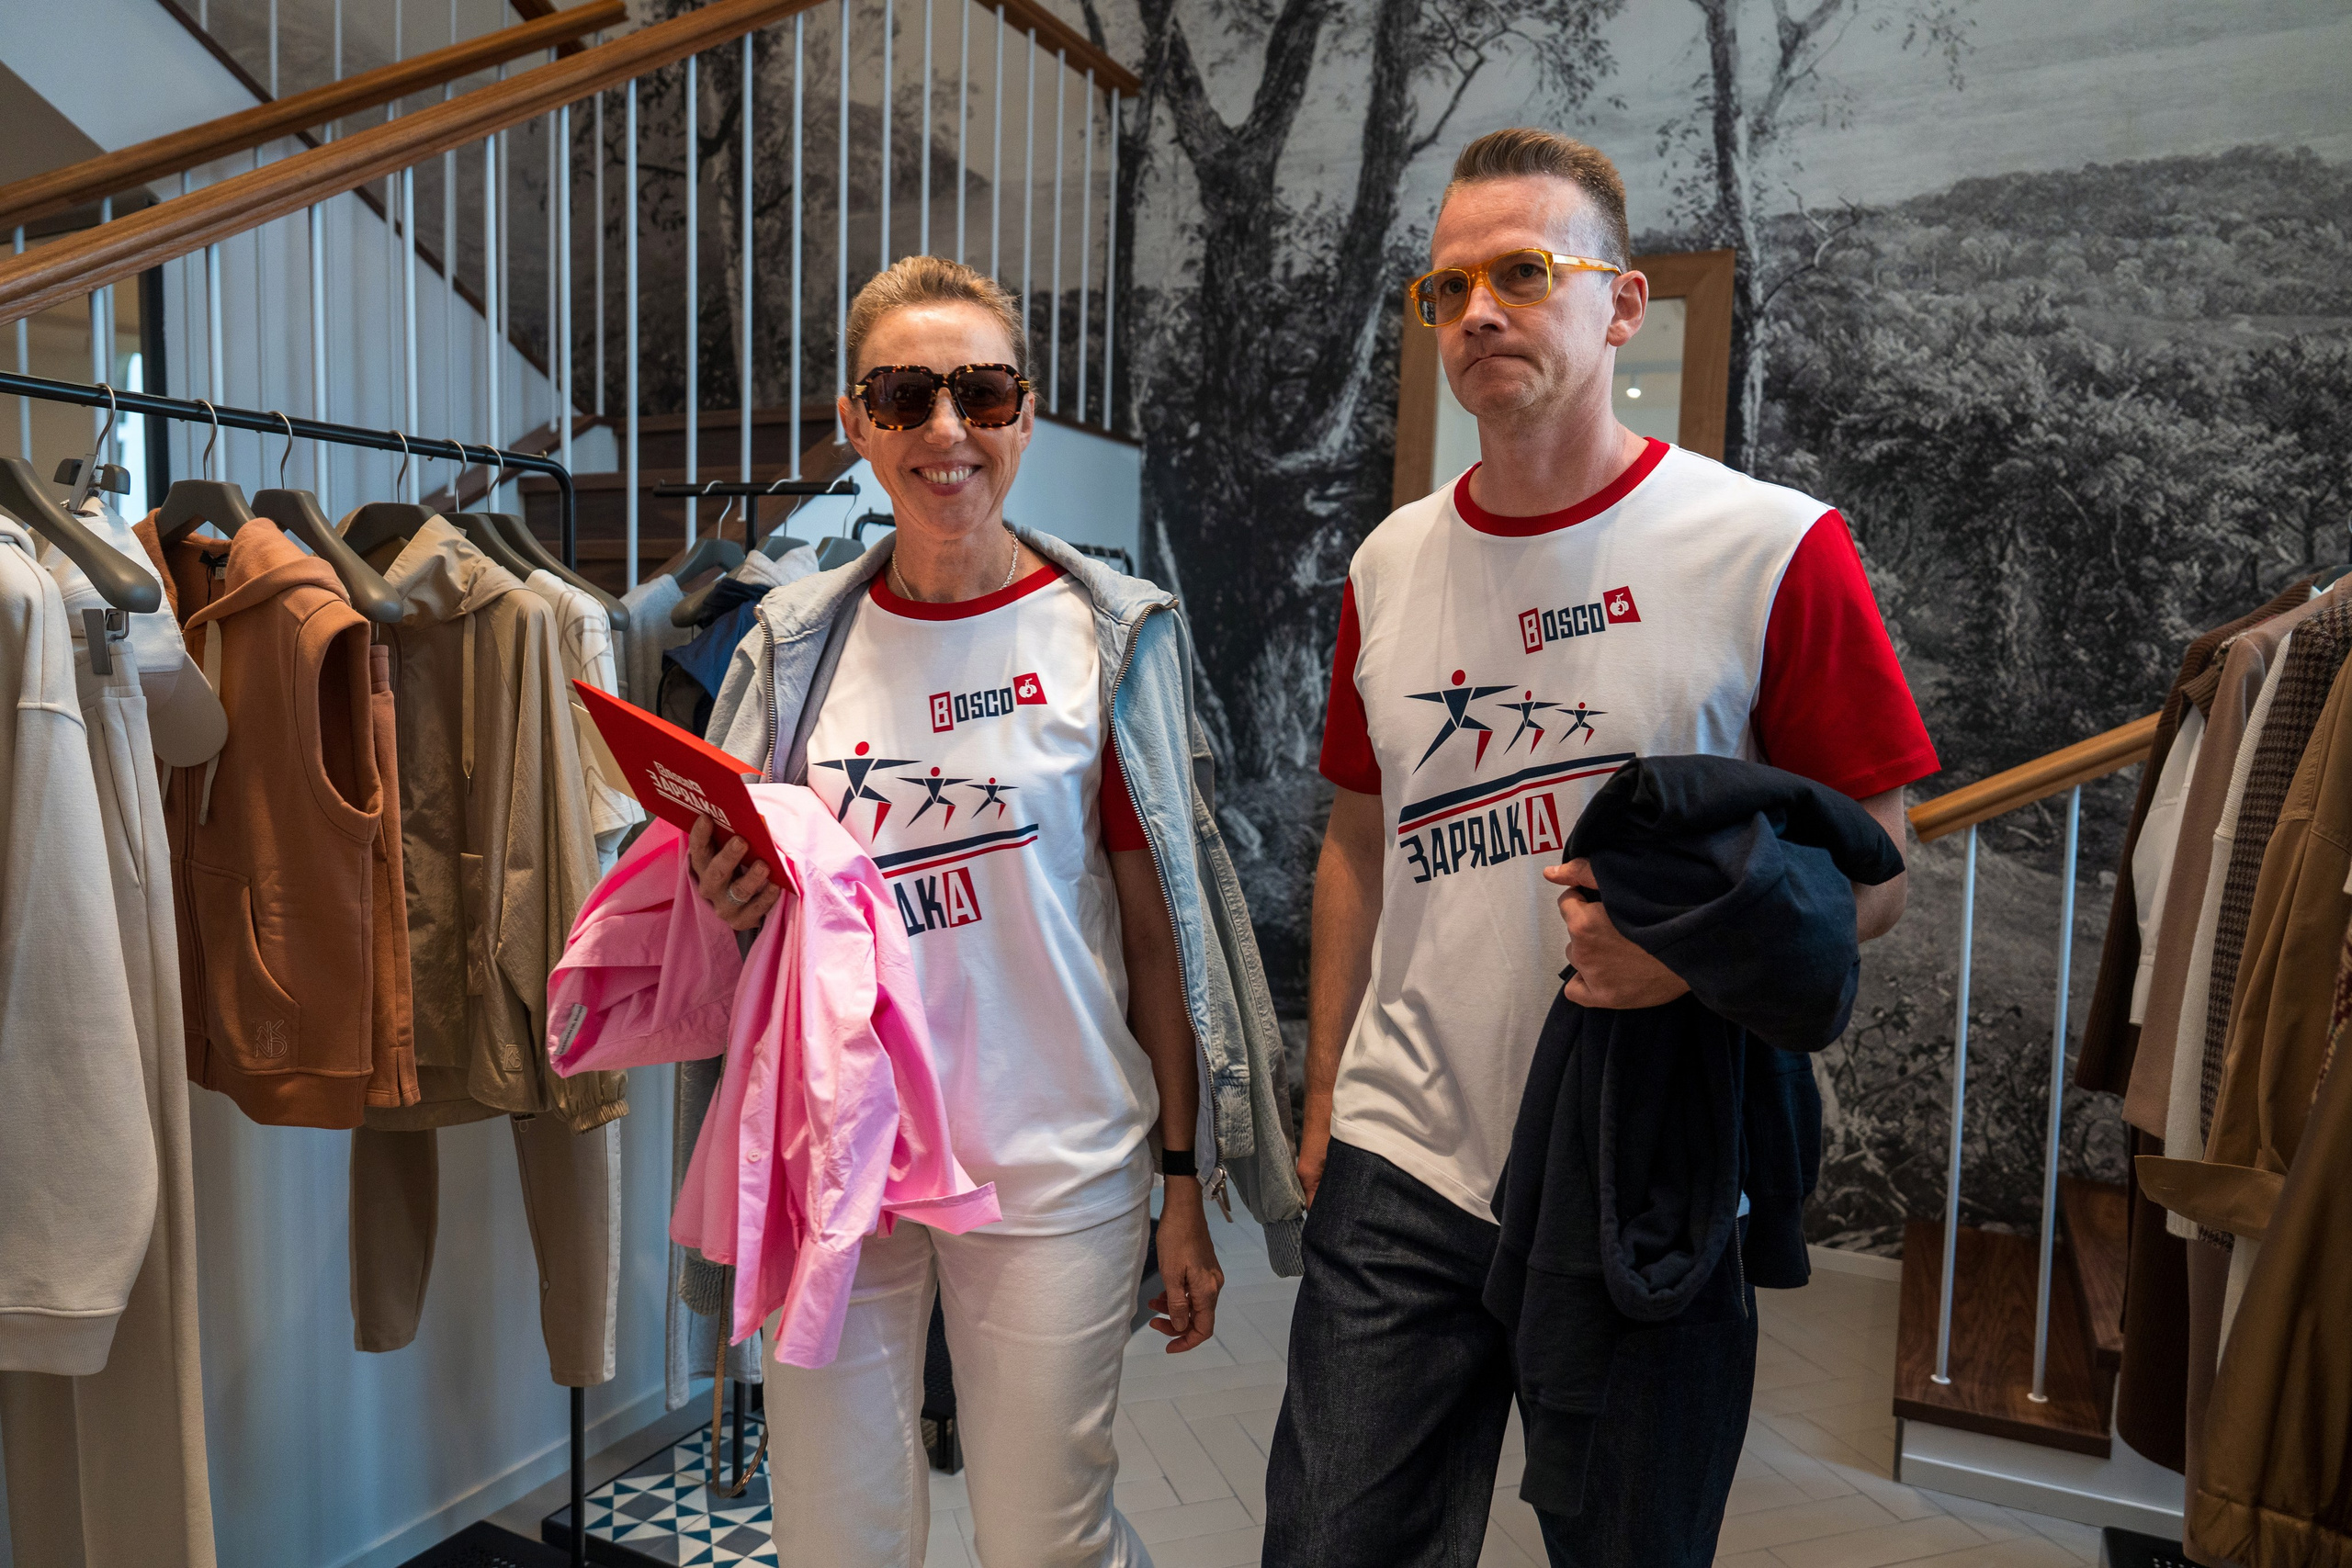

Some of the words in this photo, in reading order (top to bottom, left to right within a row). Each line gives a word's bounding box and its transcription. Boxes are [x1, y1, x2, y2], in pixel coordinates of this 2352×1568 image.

[1518, 603, 1606, 655] BOSCO
[929, 687, 1014, 733] BOSCO
[646, 769, 731, 827] ЗАРЯДКА
[1399, 792, 1564, 883] ЗАРЯДКА
[893, 866, 982, 938] ДКА
